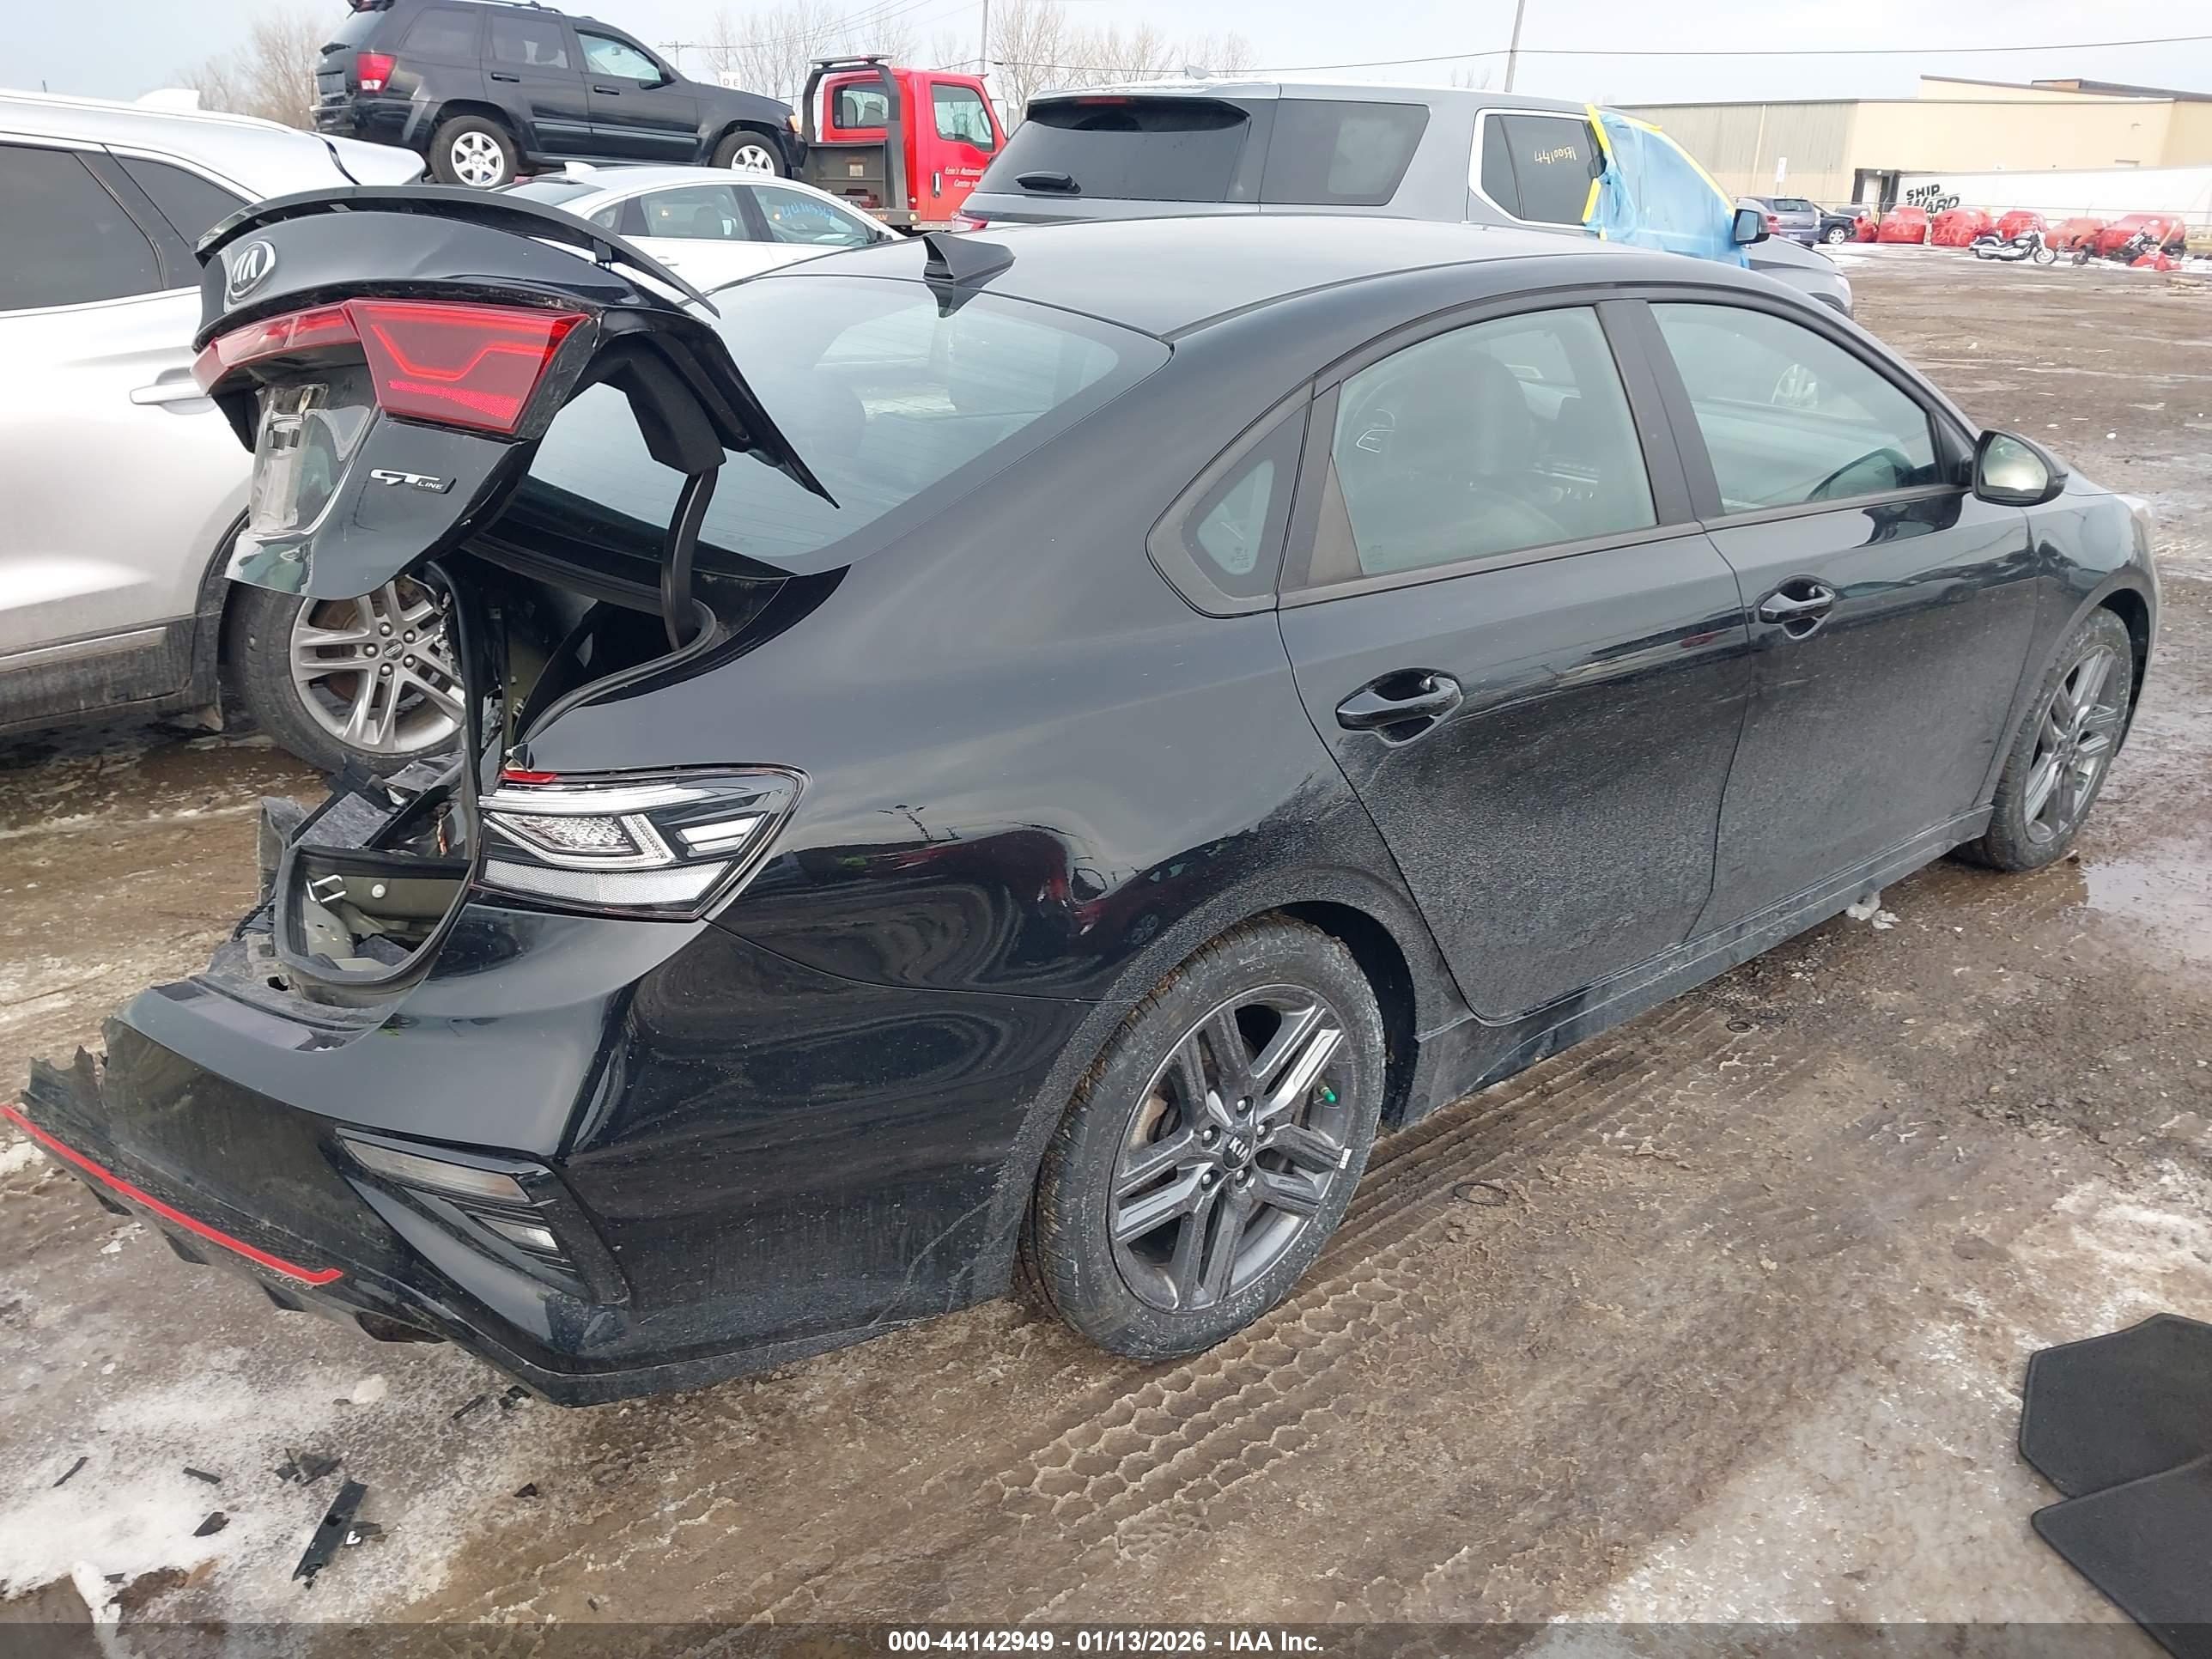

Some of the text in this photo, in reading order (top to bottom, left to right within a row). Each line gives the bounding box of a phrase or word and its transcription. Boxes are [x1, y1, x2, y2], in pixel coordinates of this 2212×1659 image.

[1905, 183, 1941, 201] SHIP
[370, 468, 445, 490] GT LINE
[1228, 1136, 1249, 1162] KIA
